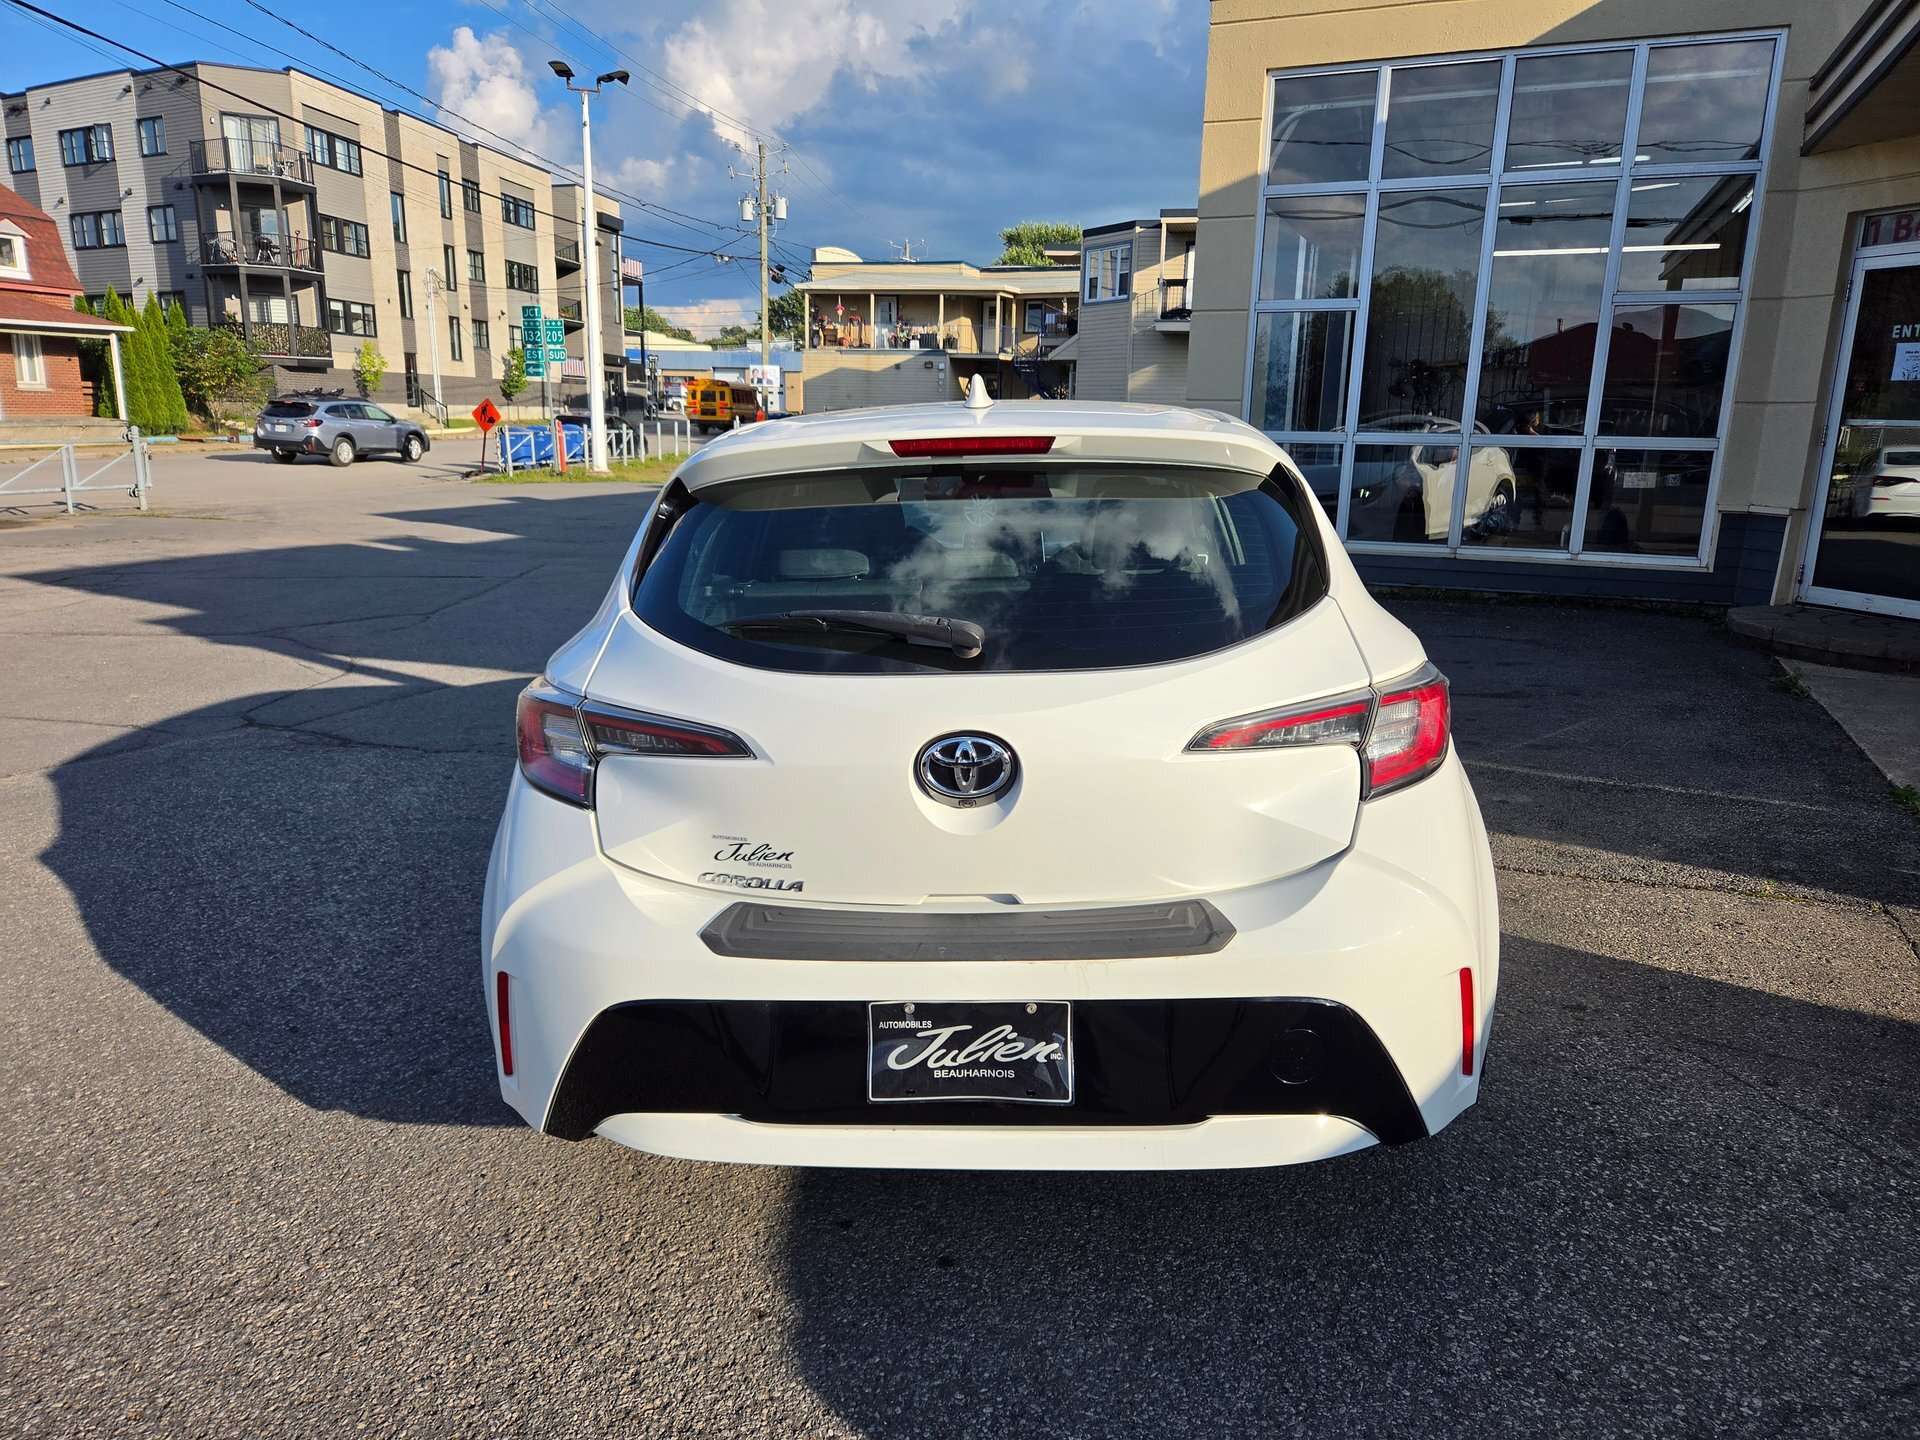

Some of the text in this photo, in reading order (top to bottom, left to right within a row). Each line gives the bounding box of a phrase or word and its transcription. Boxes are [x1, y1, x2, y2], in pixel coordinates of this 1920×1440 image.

[525, 330, 541, 342] 132
[546, 330, 563, 342] 205
[526, 350, 542, 359] EST
[549, 350, 566, 360] SUD
[714, 842, 795, 861] Julien
[698, 871, 805, 892] COROLLA
[879, 1020, 933, 1029] AUTOMOBILES
[887, 1024, 1060, 1070] Julien
[933, 1069, 1016, 1079] BEAUHARNOIS
